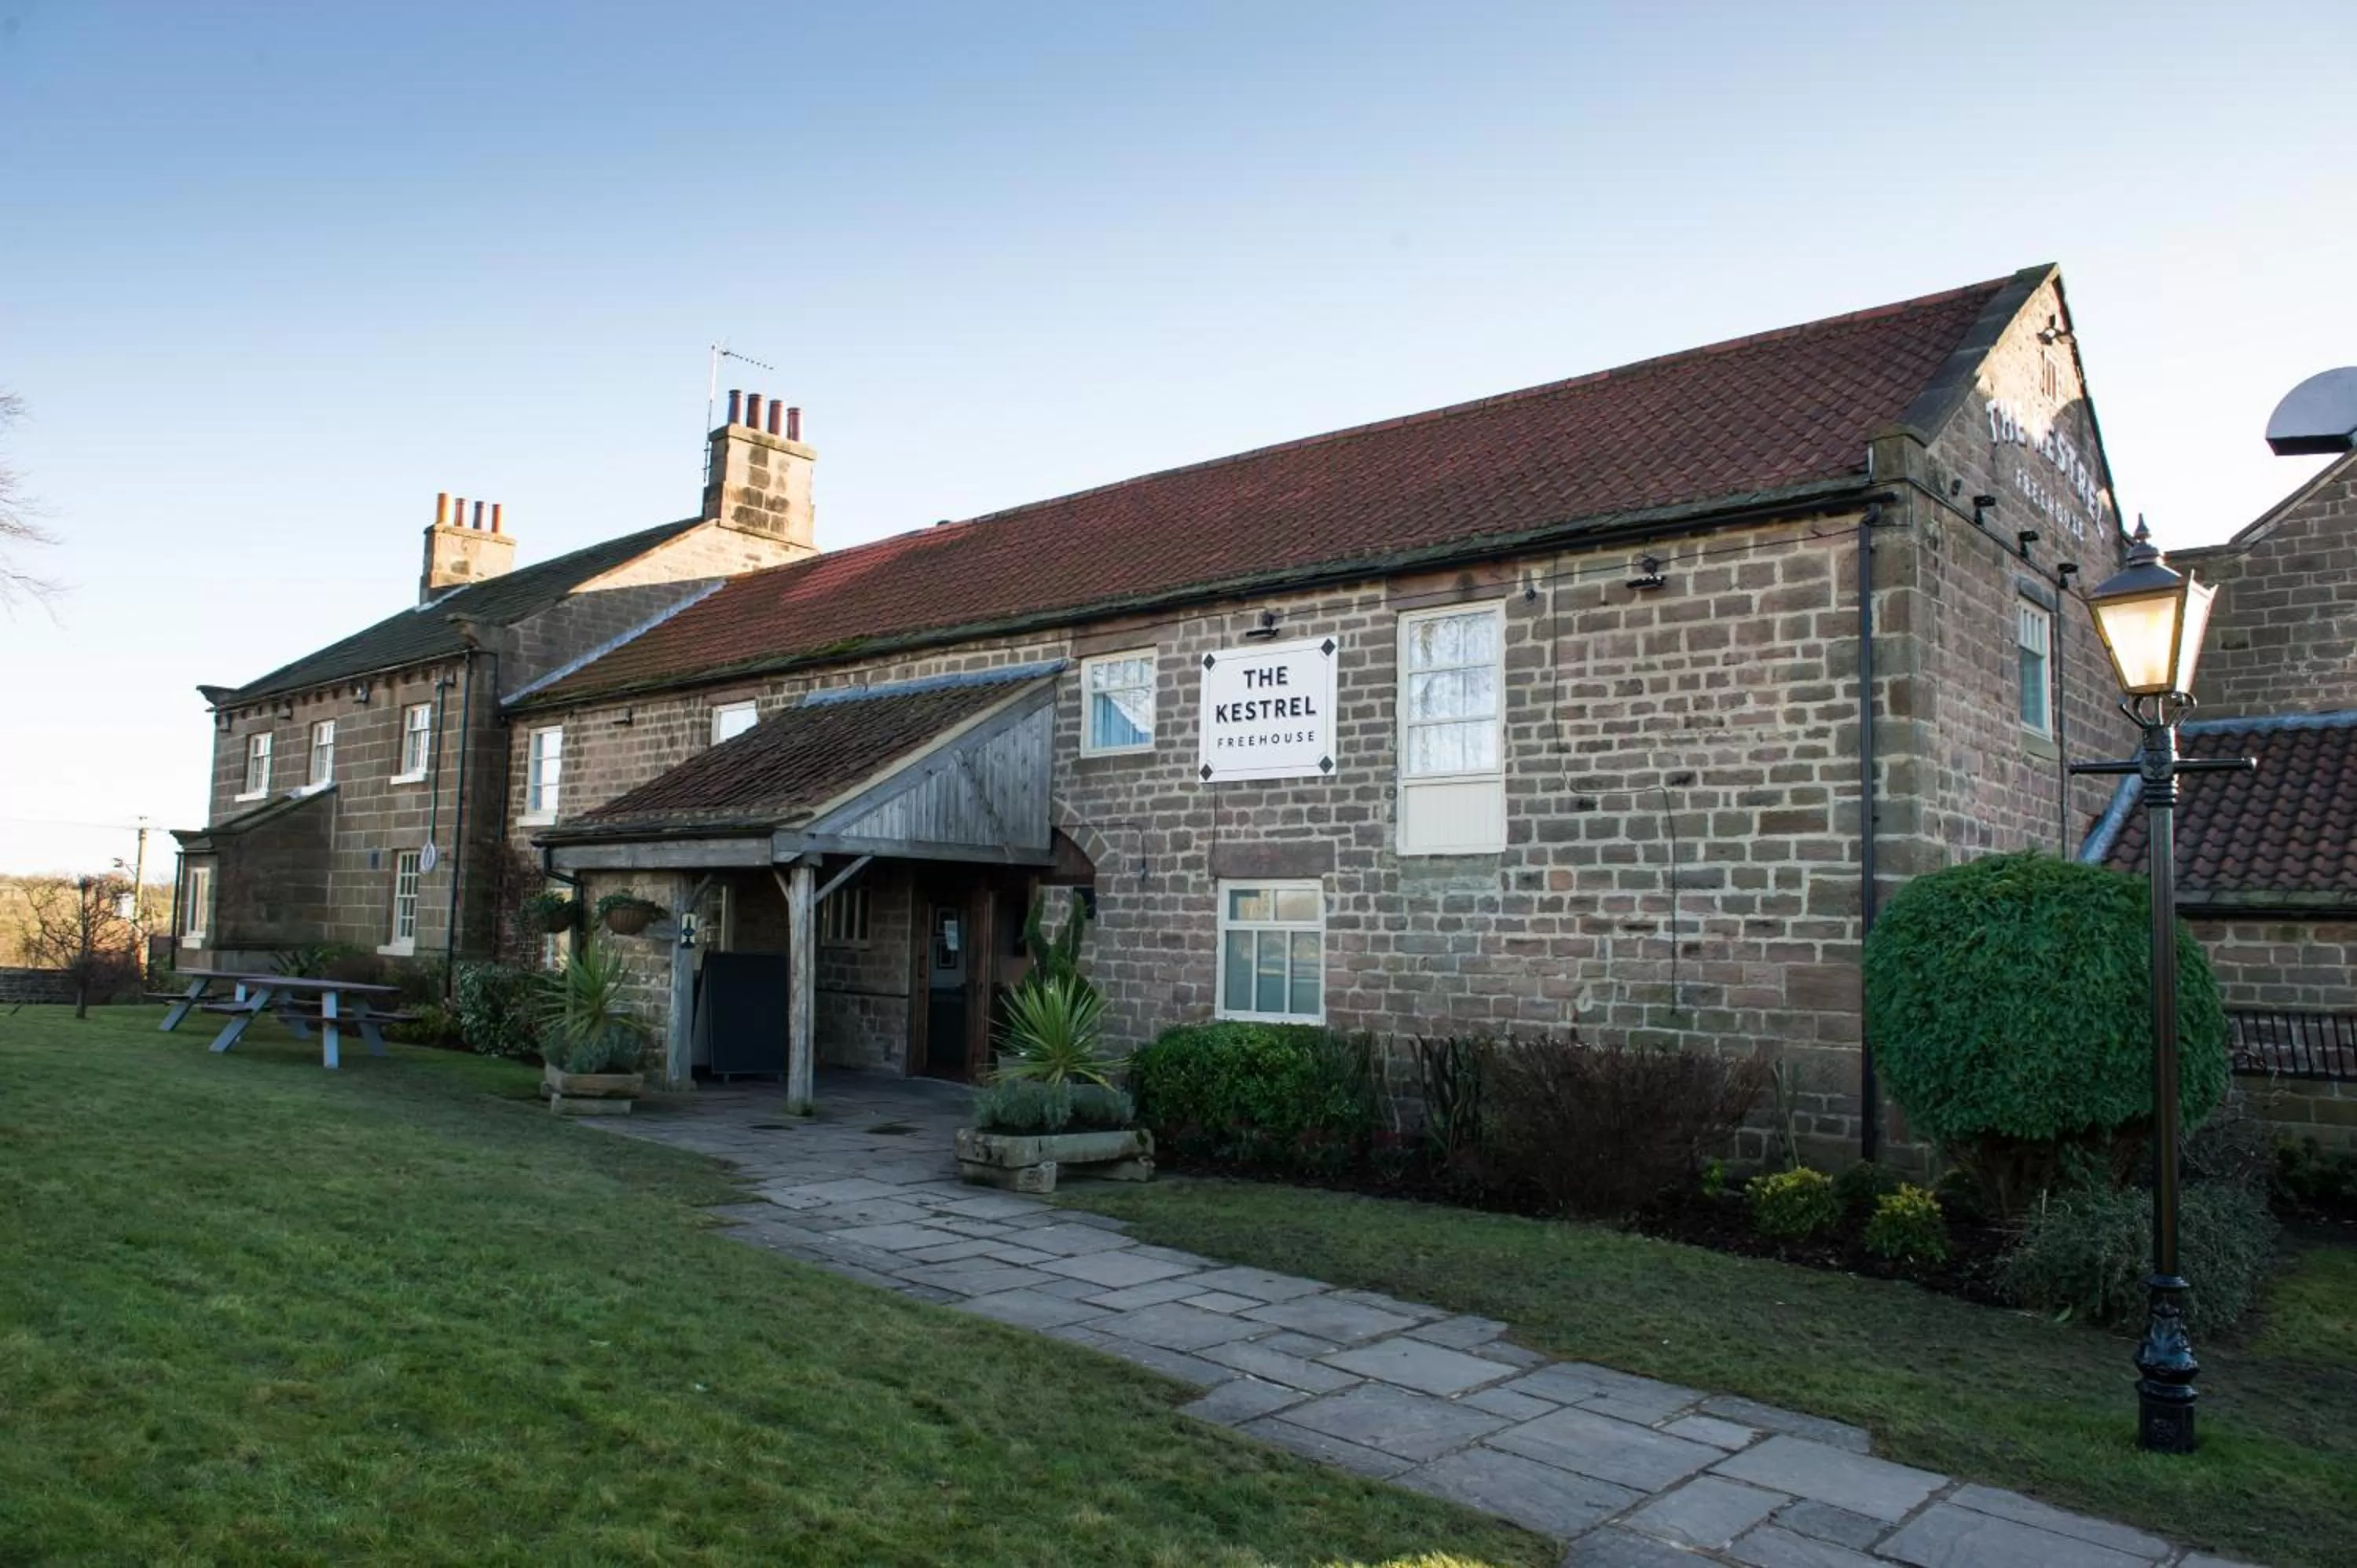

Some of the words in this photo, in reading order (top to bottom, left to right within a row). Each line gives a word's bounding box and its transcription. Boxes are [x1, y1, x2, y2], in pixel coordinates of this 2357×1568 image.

[1243, 665, 1288, 689] THE
[1215, 695, 1317, 724] KESTREL
[1217, 731, 1314, 748] FREEHOUSE
